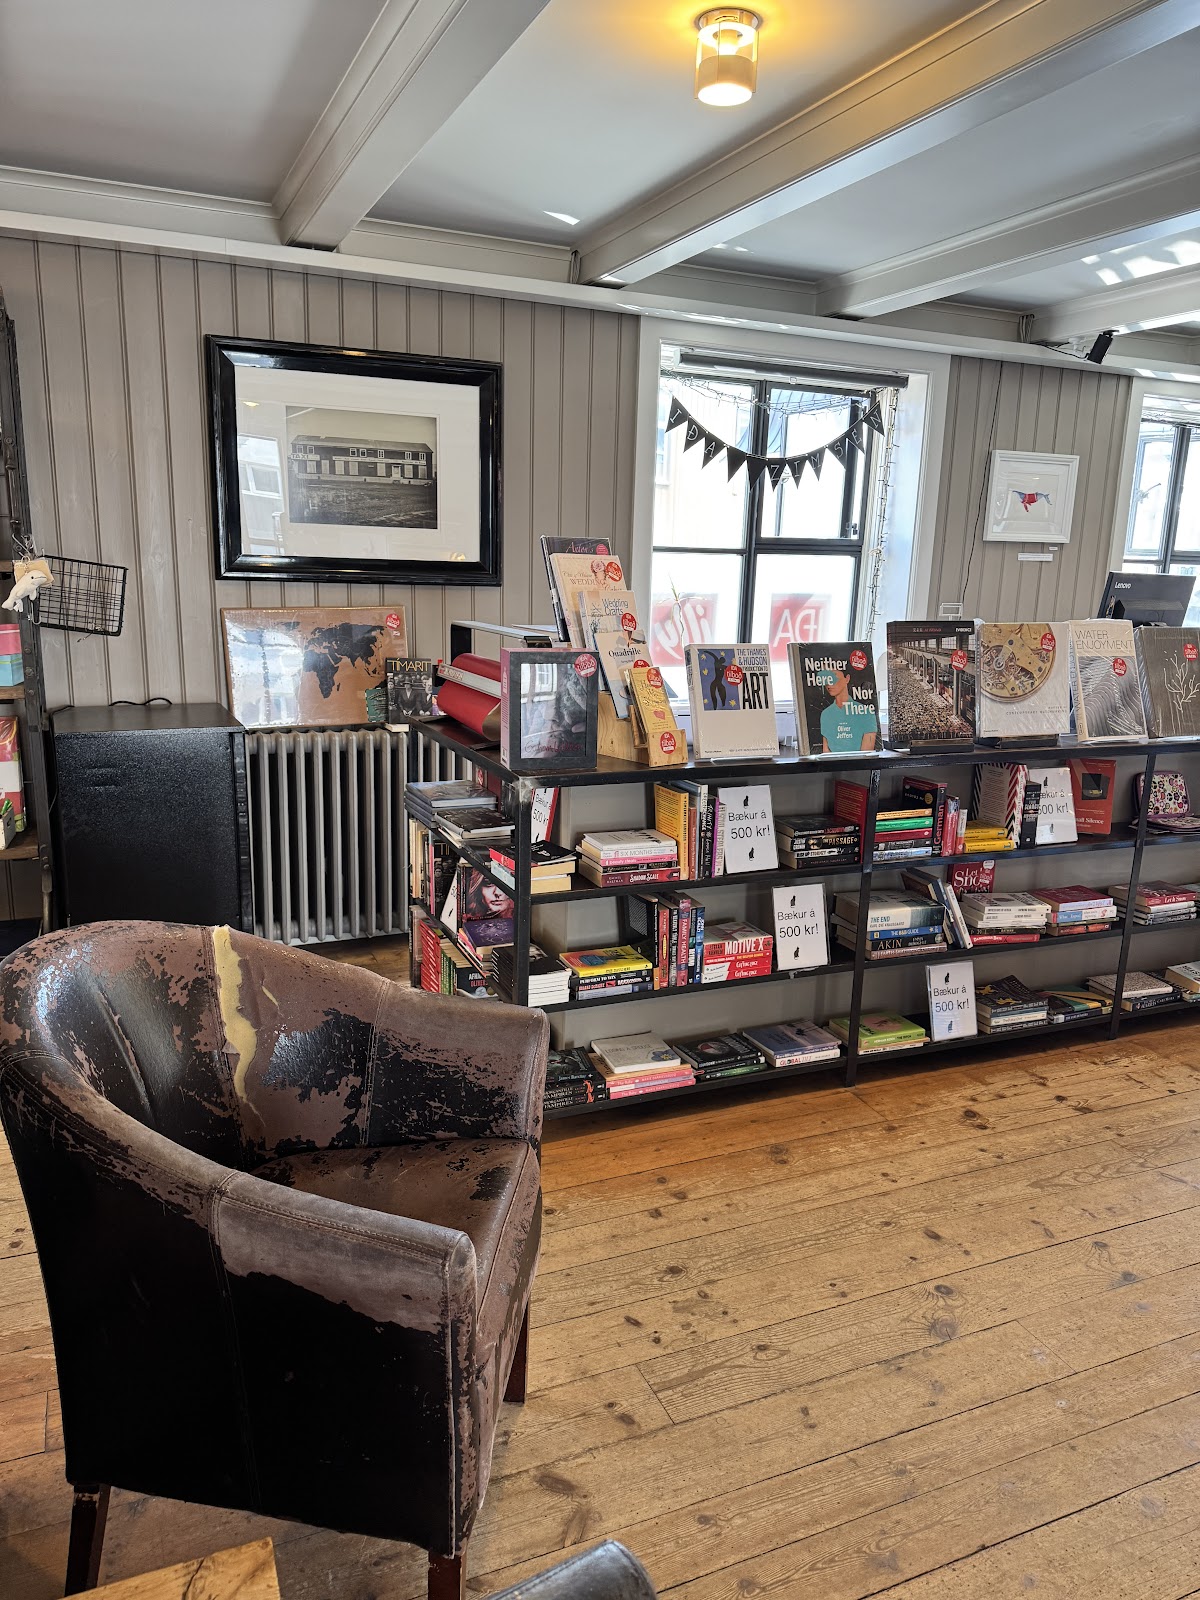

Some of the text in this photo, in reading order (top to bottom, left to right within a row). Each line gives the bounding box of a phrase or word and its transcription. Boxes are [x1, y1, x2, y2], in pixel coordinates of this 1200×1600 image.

[769, 410, 883, 482] ZIMSEN
[1115, 581, 1132, 589] Lenovo
[602, 598, 629, 609] Wedding
[604, 606, 624, 616] Crafts
[1075, 630, 1109, 640] WATER
[1076, 640, 1134, 650] ENJOYMENT
[608, 647, 641, 658] Quadrille
[737, 648, 767, 656] THE THAMES
[388, 658, 432, 672] TÍMARIT
[739, 657, 768, 666] & HUDSON
[804, 656, 848, 671] Neither
[806, 673, 834, 686] Here
[742, 672, 770, 710] ART
[852, 686, 874, 700] Nor
[842, 701, 876, 715] There
[1039, 789, 1058, 799] ækur
[1056, 802, 1069, 814] kr!
[533, 808, 543, 823] 500
[728, 809, 767, 822] Bækur á
[1085, 817, 1105, 825] Silence
[933, 805, 944, 845] German
[730, 824, 771, 840] 500 kr!
[828, 836, 854, 846] PASSAGE
[628, 849, 653, 857] MONTHS
[954, 870, 981, 887] Sno
[966, 868, 978, 877] Let
[777, 908, 816, 921] Bækur á
[779, 923, 820, 939] 500 kr!
[725, 937, 765, 956] MOTIVE X
[878, 939, 903, 950] AKIN
[933, 984, 967, 997] Bækur á
[935, 998, 970, 1013] 500 kr!
[780, 1057, 801, 1066] GLOBAL
